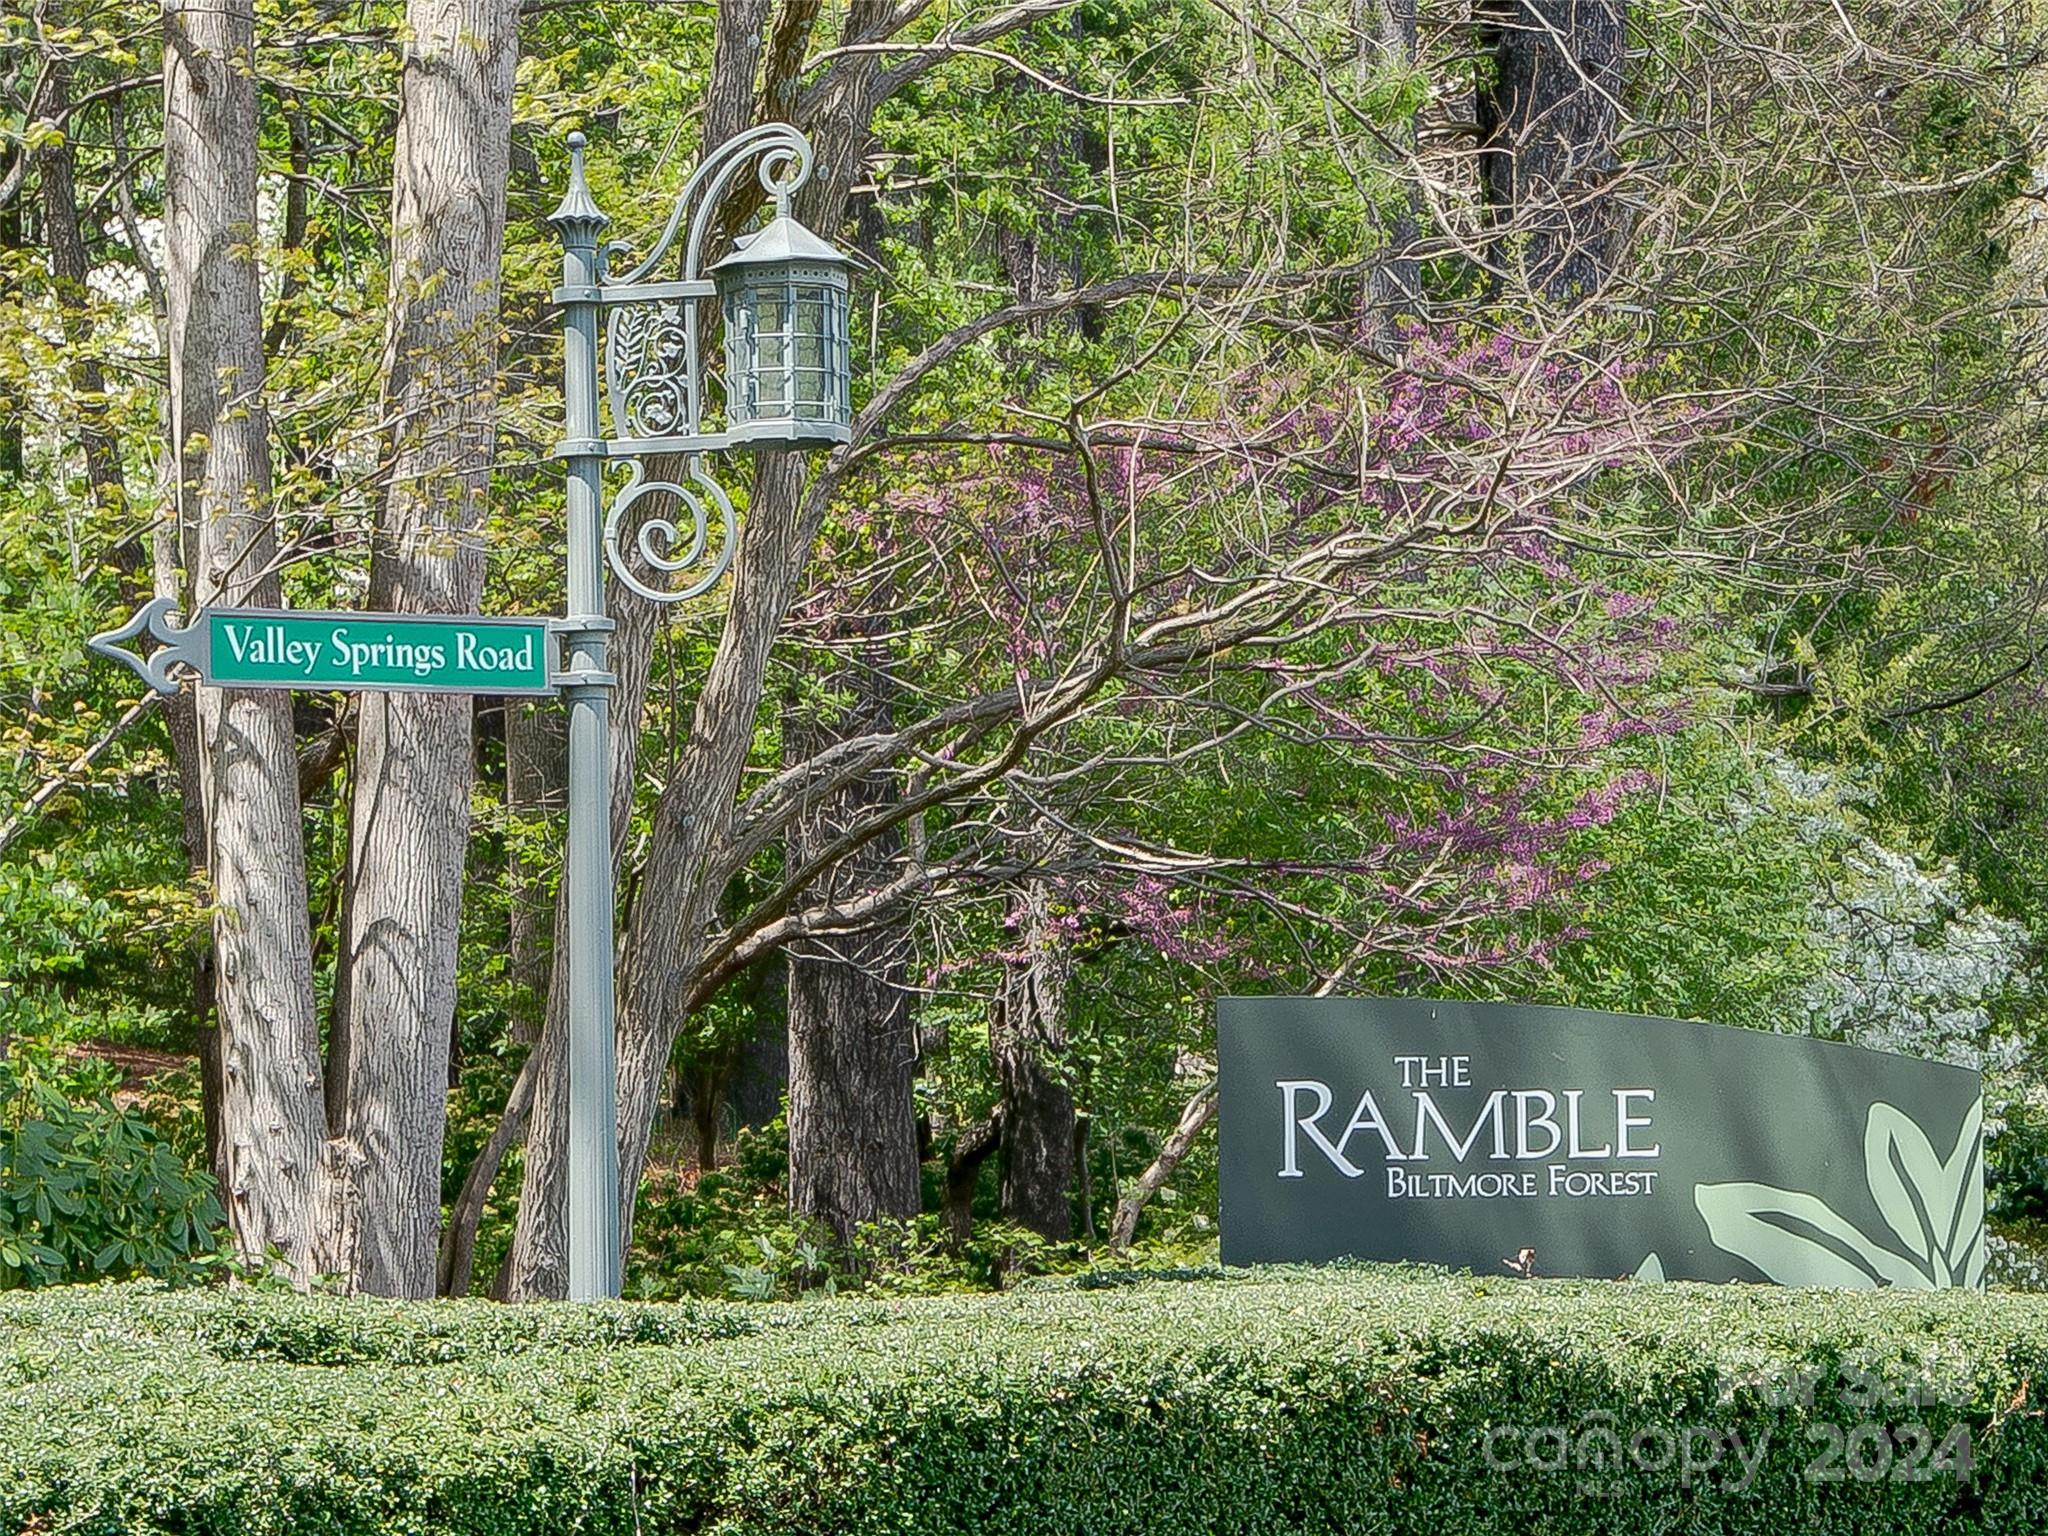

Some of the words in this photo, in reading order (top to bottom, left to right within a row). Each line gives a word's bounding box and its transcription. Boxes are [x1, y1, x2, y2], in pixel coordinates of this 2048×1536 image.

[224, 624, 322, 674] Valley
[331, 628, 446, 676] Springs
[455, 632, 535, 671] Road
[1394, 1056, 1472, 1087] THE
[1275, 1080, 1661, 1178] RAMBLE
[1386, 1166, 1537, 1198] BILTMORE
[1548, 1165, 1658, 1195] FOREST
